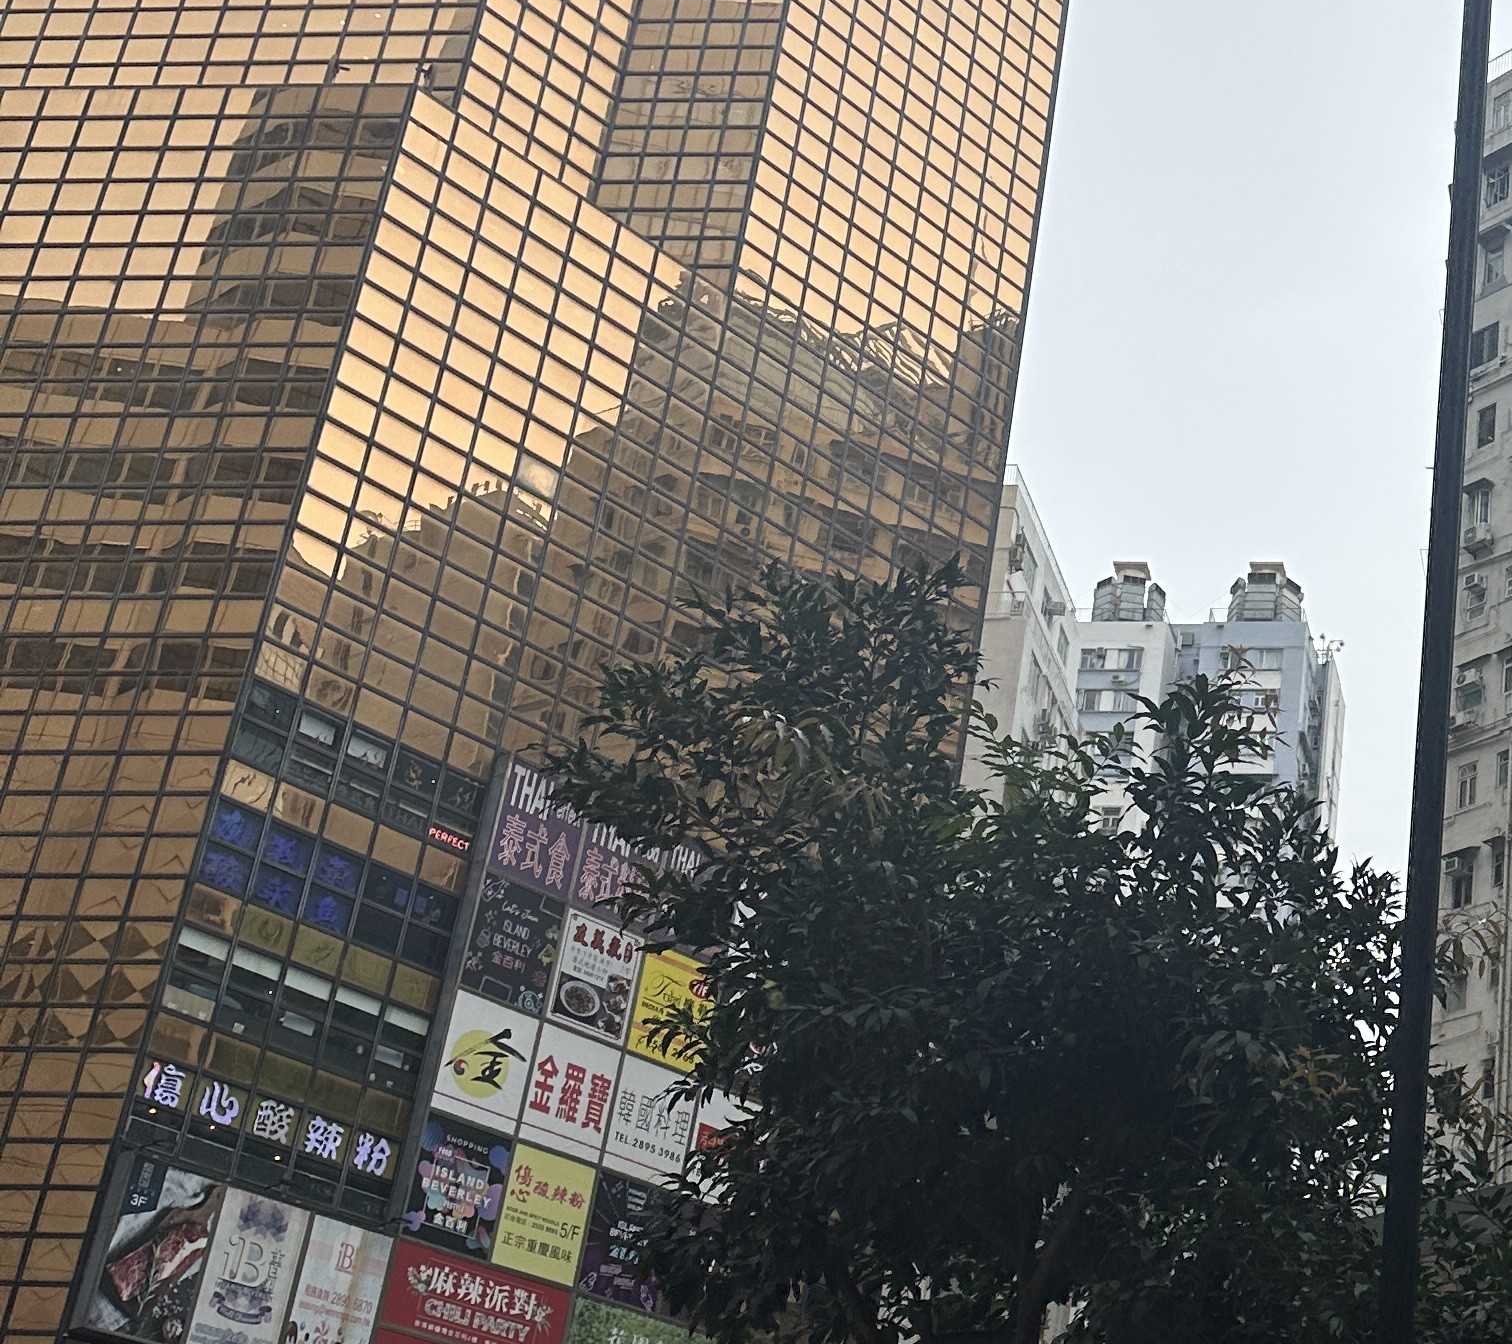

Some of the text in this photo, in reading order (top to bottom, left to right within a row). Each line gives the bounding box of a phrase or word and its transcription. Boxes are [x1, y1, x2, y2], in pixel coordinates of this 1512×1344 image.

[428, 827, 470, 851] PERFECT
[498, 813, 571, 890] 泰式食
[502, 920, 530, 940] ISLAND
[493, 932, 533, 958] BEVERLEY
[491, 951, 526, 974] 金百利
[144, 1061, 391, 1176] 傷心酸辣粉
[446, 1134, 489, 1156] SHOPPING
[658, 1145, 681, 1164] 3986
[435, 1165, 485, 1191] ISLAND
[422, 1177, 491, 1209] BEVERLEY
[432, 1213, 468, 1235] 金百利
[559, 1222, 582, 1242] 5/F
[501, 1231, 573, 1264] 正宗重慶風味
[428, 1265, 541, 1321] 麻辣派對
[472, 1310, 531, 1343] PARTY
